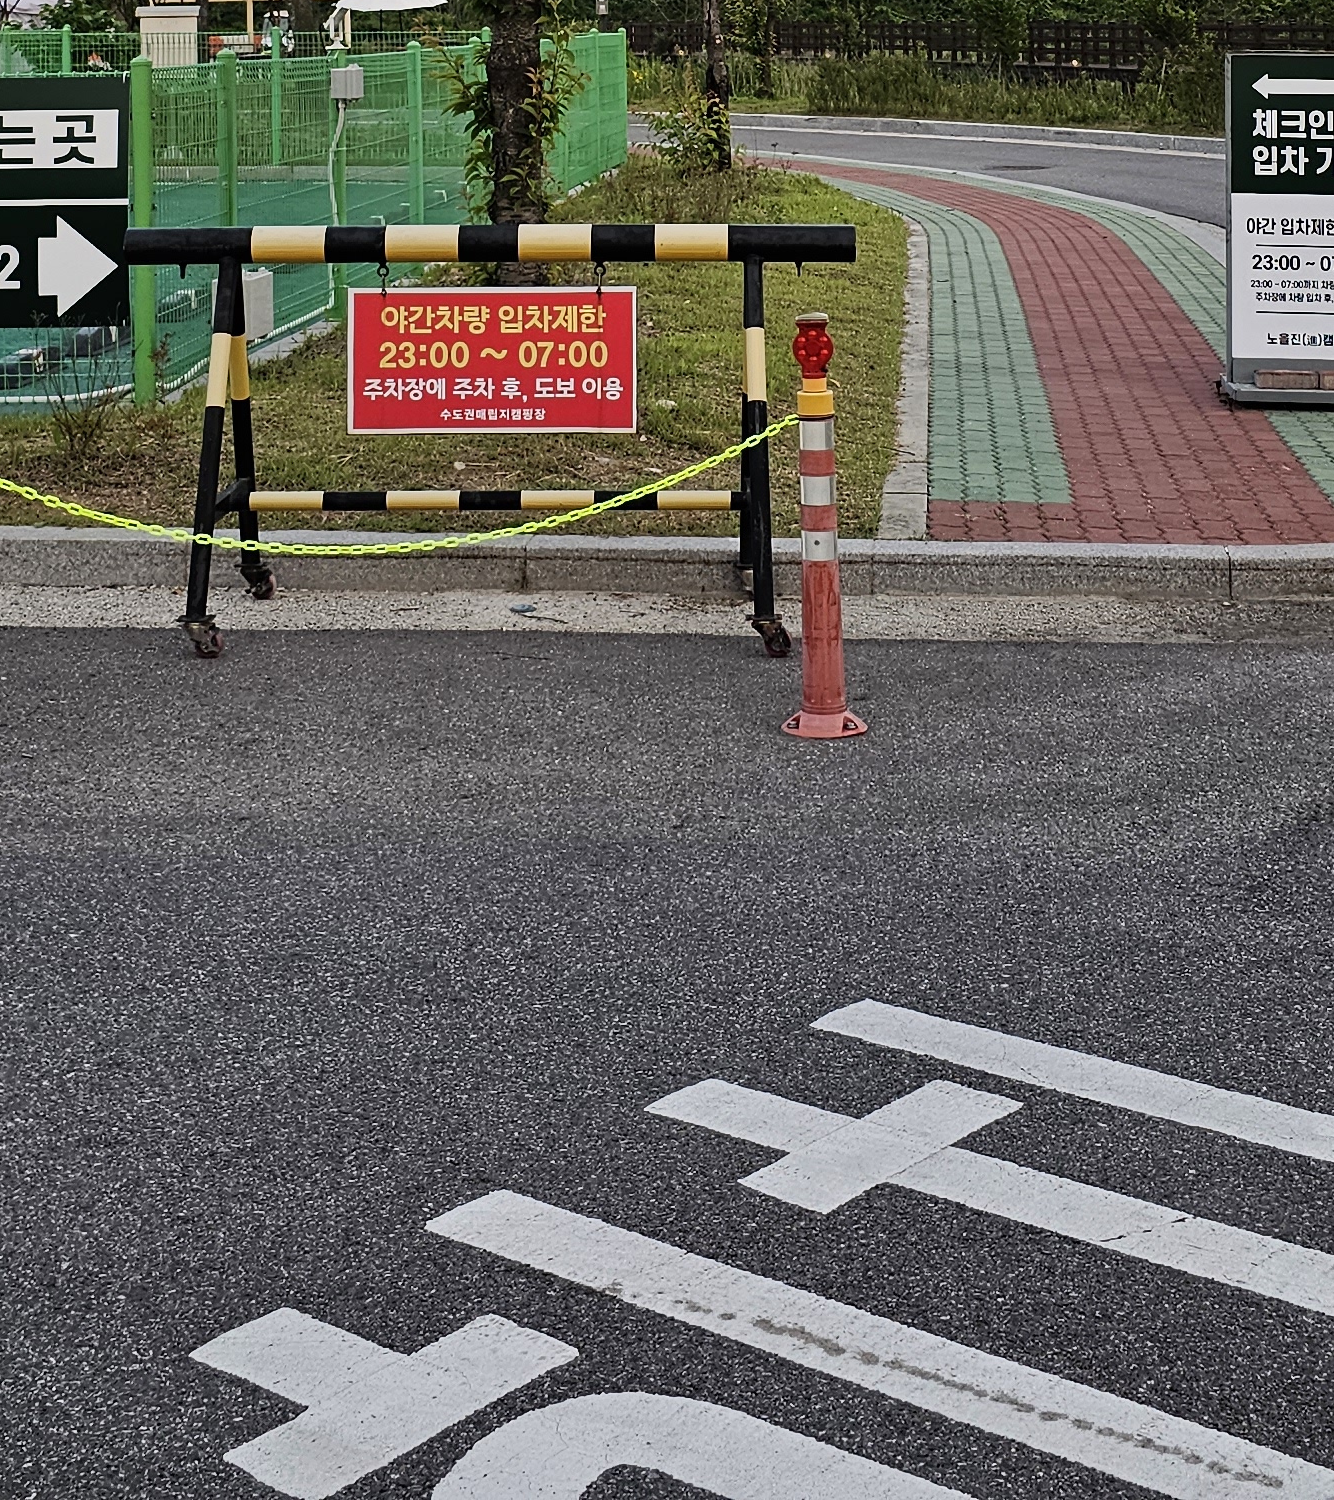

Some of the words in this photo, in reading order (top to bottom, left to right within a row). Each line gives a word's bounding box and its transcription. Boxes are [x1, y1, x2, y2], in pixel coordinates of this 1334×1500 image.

[1252, 109, 1334, 139] 체크인
[52, 114, 98, 166] 곳
[1252, 146, 1309, 176] 입차
[1247, 218, 1276, 235] 야간
[1252, 255, 1300, 270] 23:00
[1251, 280, 1272, 288] 23:00
[1281, 280, 1319, 289] 07:00까지
[1256, 292, 1286, 302] 주차장에
[380, 305, 490, 334] 야간차량
[498, 305, 606, 333] 입차제한
[379, 341, 469, 368] 23:00
[519, 341, 608, 368] 07:00
[363, 378, 445, 401] 주차장에
[452, 379, 495, 400] 주차
[500, 378, 528, 402] 후,
[534, 378, 576, 399] 도보
[581, 378, 623, 399] 이용
[440, 408, 545, 421] 수도권매립지캠핑장
